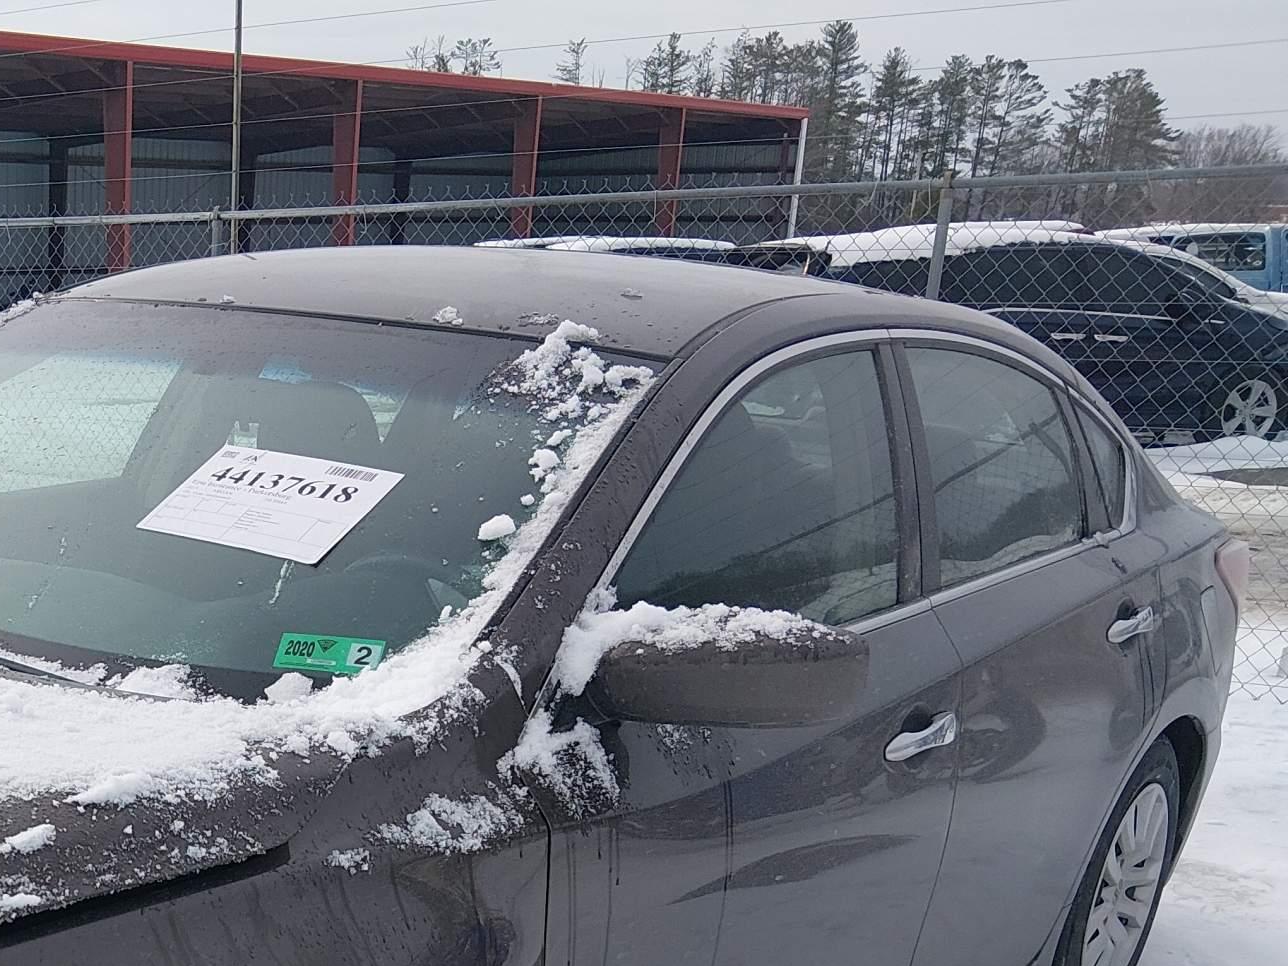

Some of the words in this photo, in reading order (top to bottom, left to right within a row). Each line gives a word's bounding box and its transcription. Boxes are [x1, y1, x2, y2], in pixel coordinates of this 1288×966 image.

[212, 466, 359, 503] 44137618
[284, 640, 316, 657] 2020
[354, 646, 373, 666] 2
